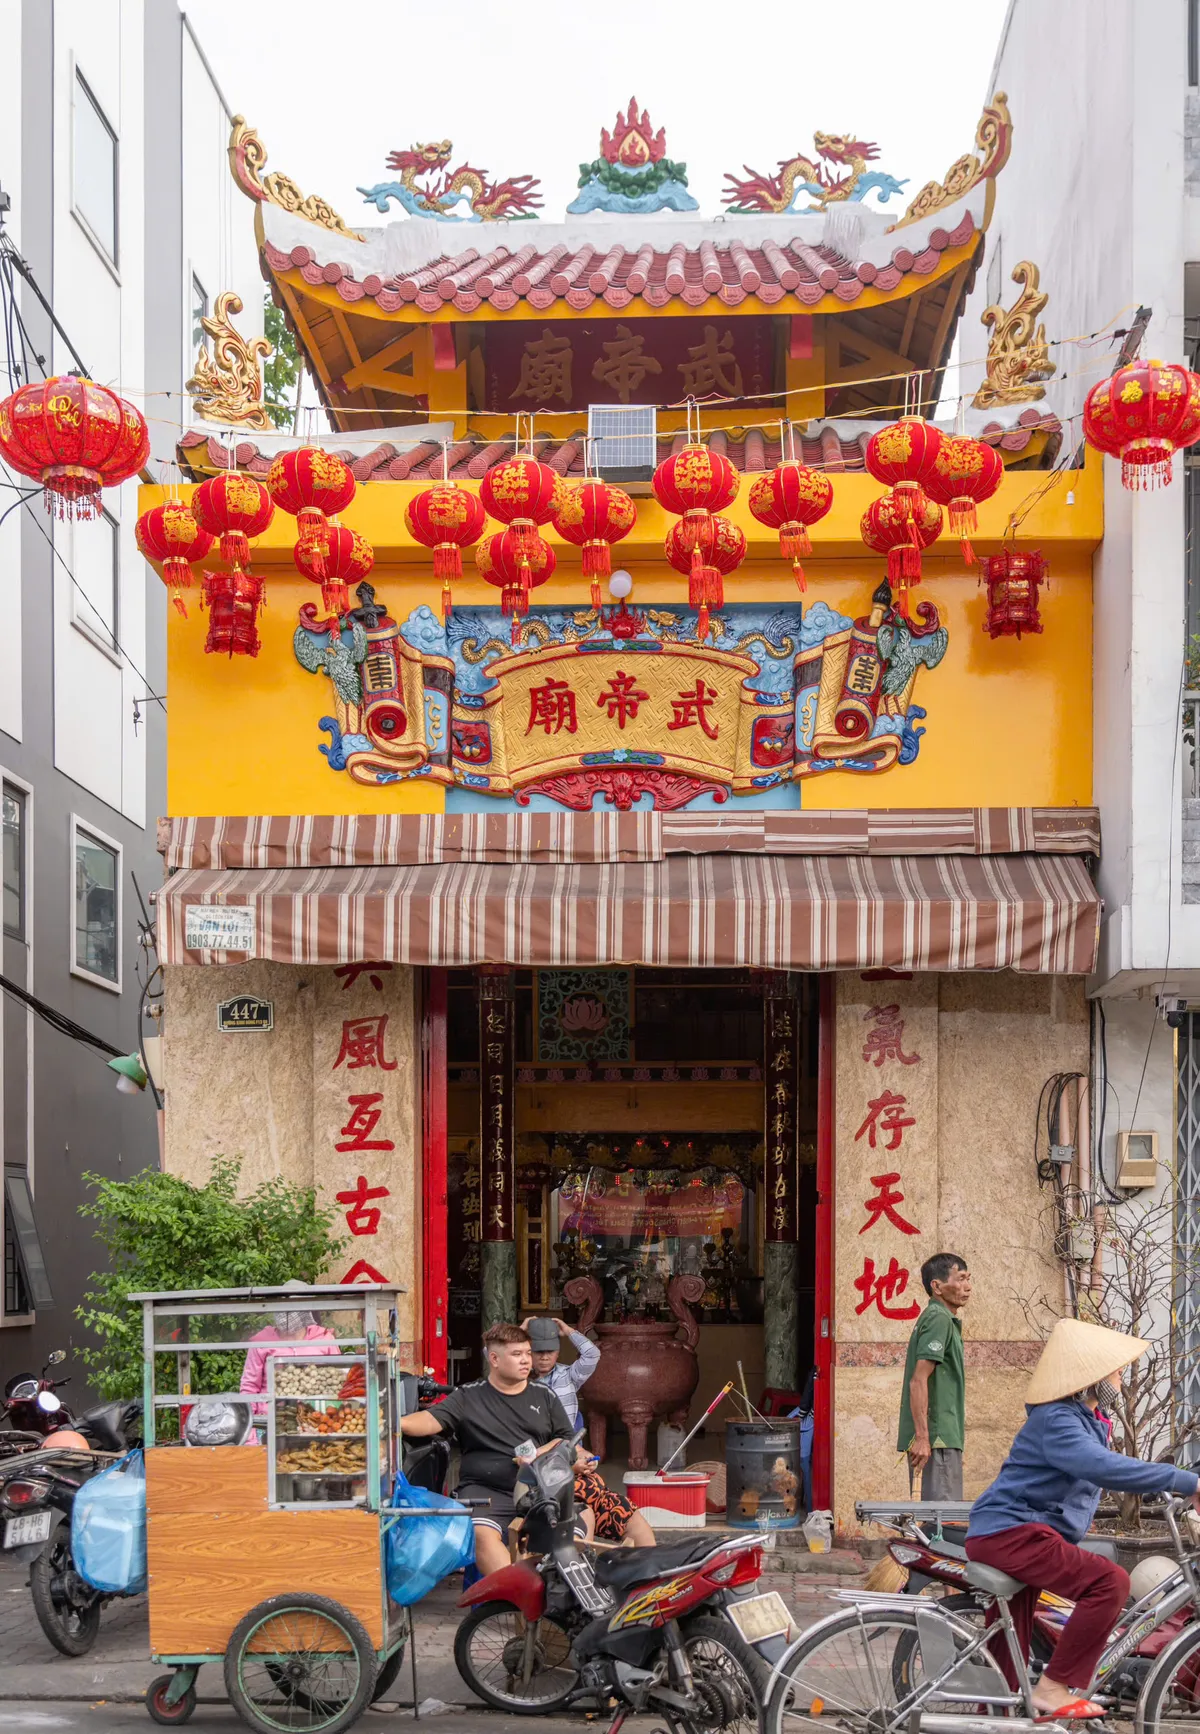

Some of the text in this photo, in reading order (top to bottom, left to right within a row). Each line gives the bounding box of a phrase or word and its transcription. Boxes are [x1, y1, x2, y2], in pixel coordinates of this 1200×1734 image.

[524, 670, 719, 740] 武帝廟
[186, 933, 253, 949] 0903.77.44.51
[230, 1003, 260, 1020] 447
[854, 971, 923, 1321] 氣存天地
[1108, 1632, 1141, 1664] martin
